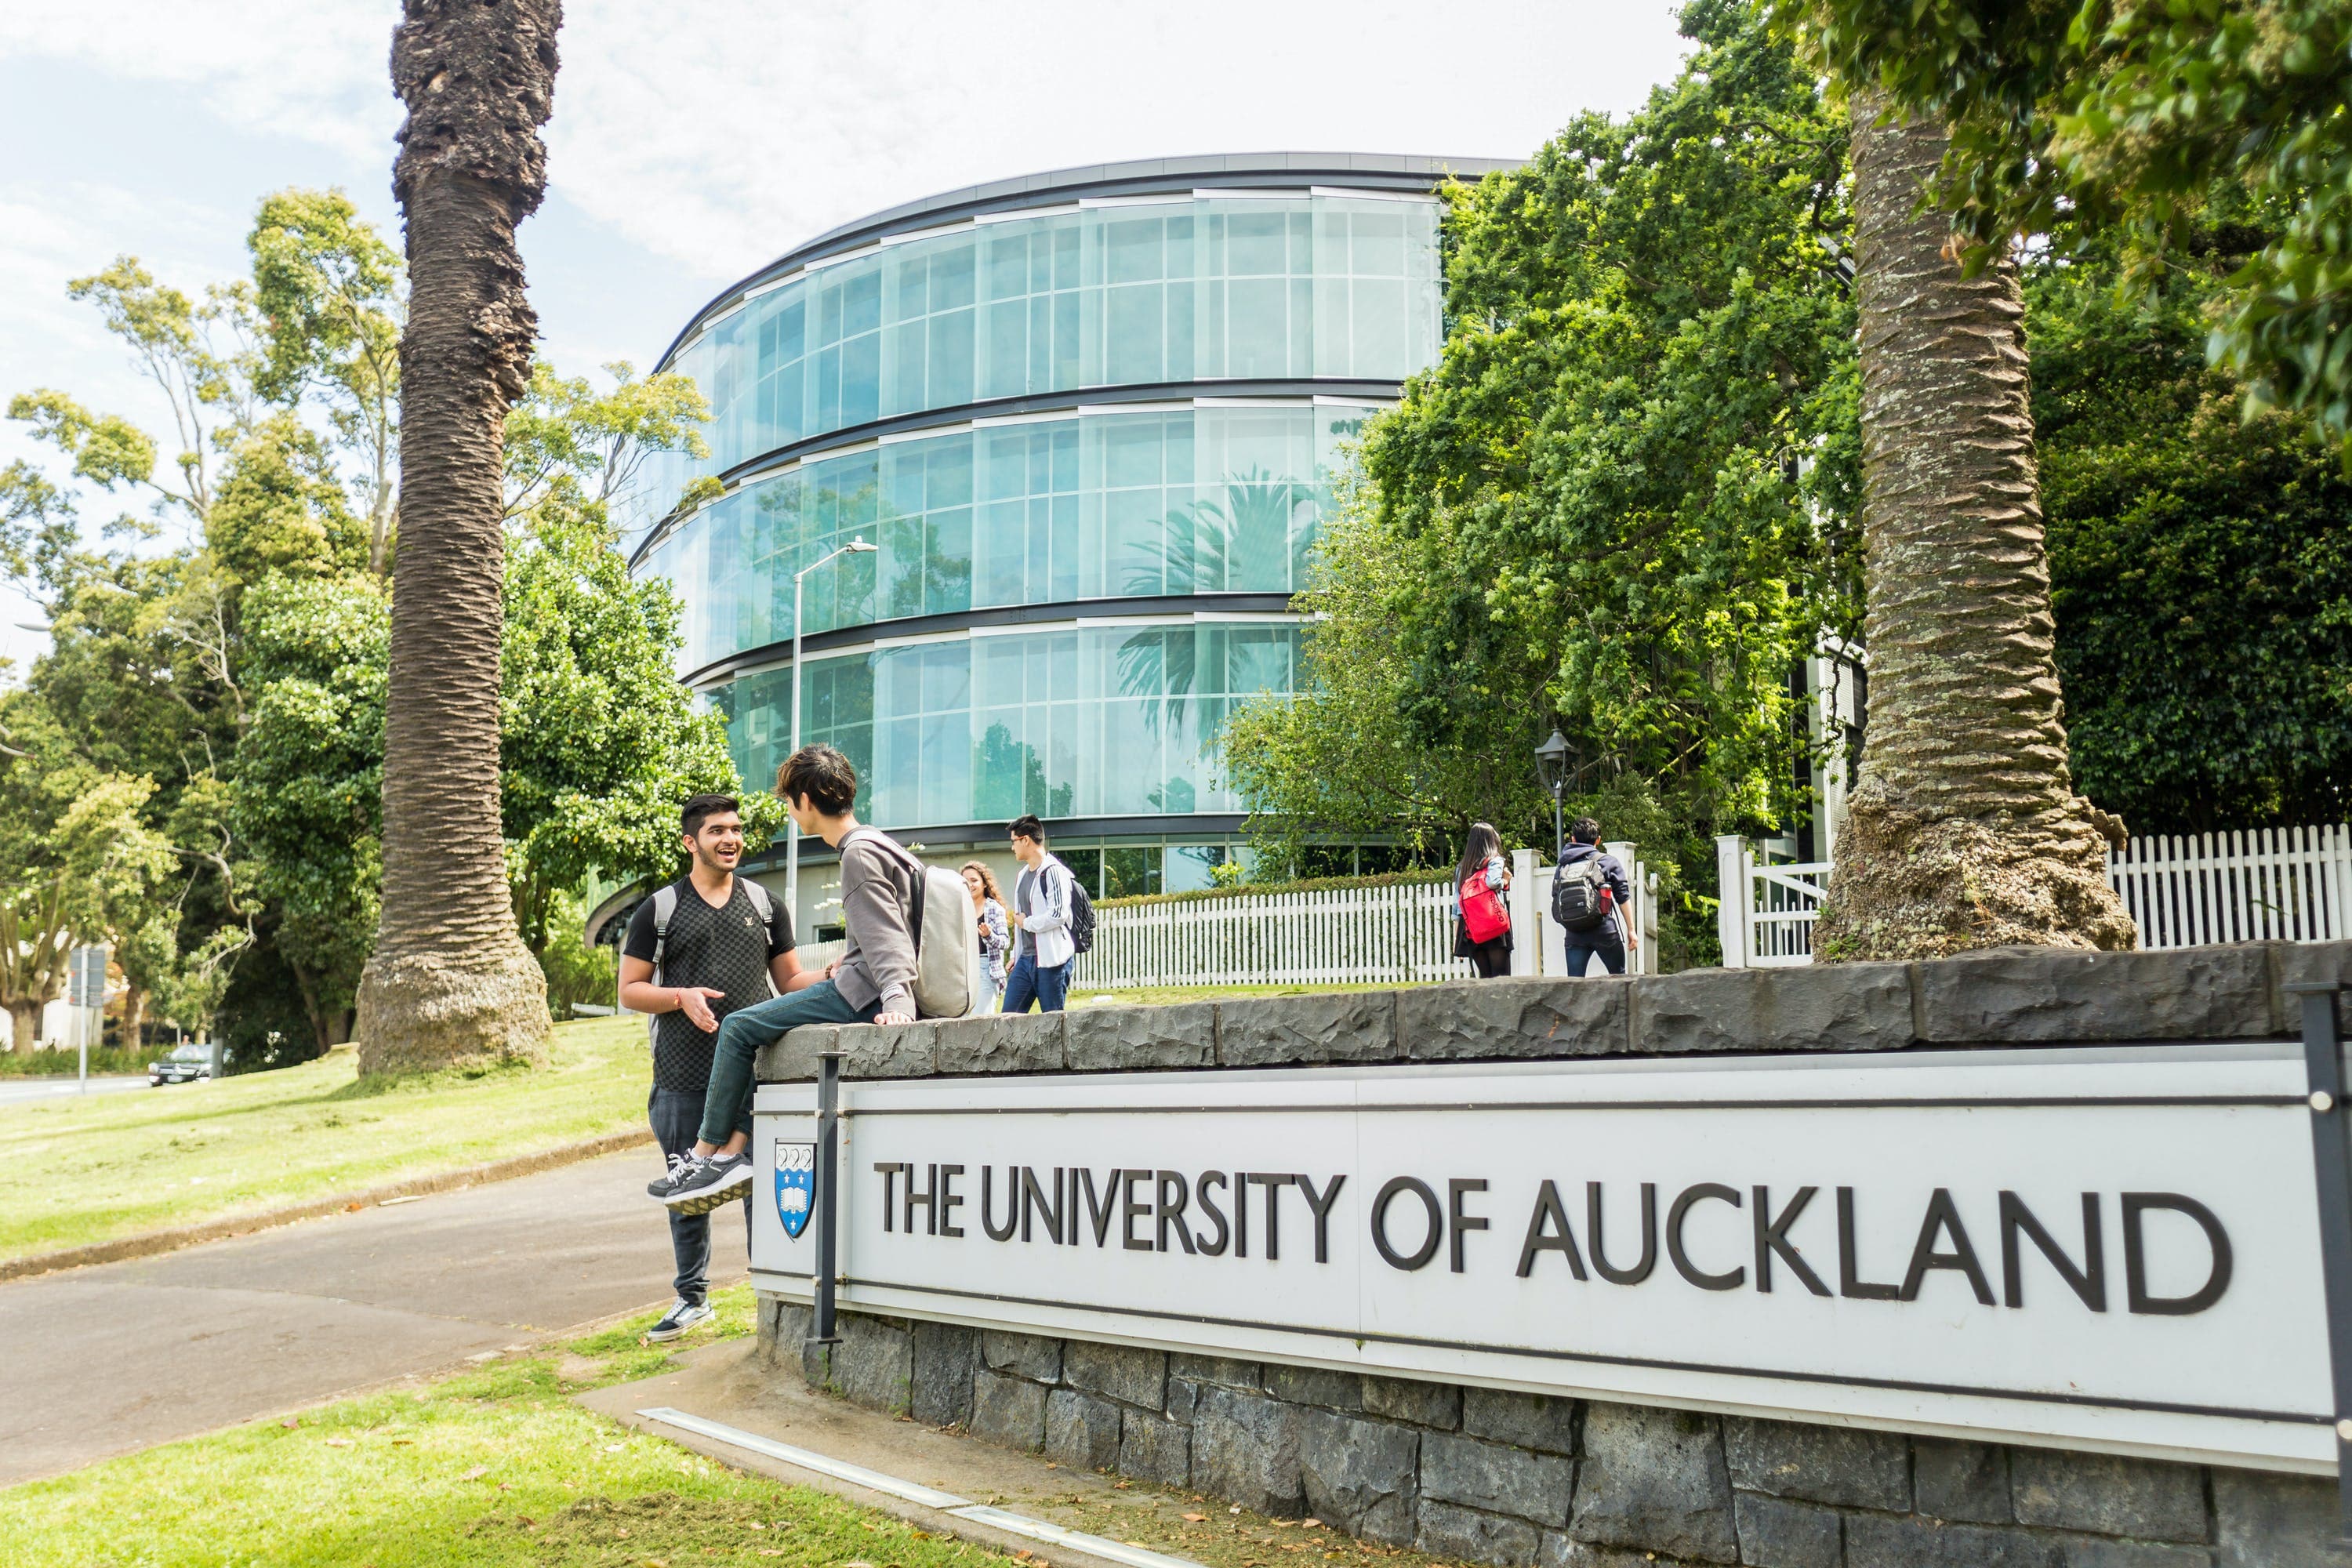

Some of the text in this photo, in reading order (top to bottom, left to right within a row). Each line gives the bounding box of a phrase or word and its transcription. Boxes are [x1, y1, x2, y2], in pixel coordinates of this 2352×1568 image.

[873, 1163, 2234, 1316] THE UNIVERSITY OF AUCKLAND
